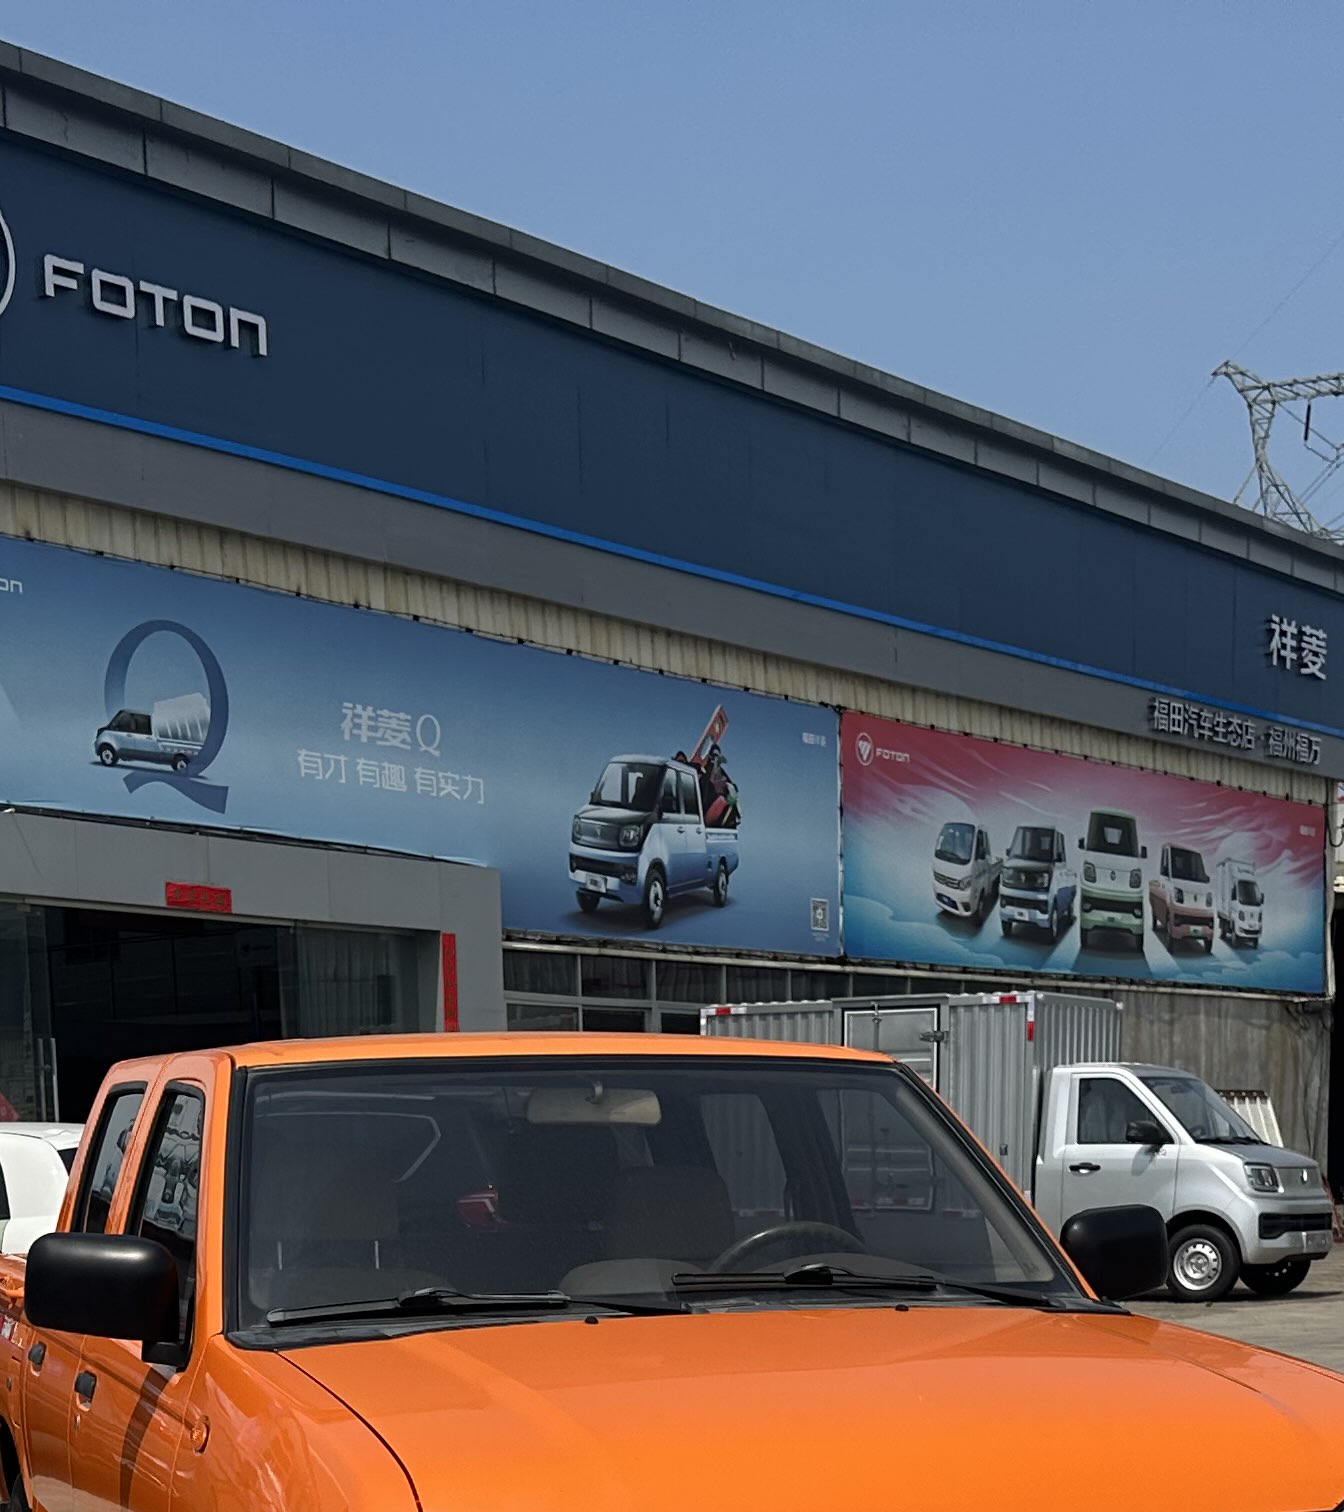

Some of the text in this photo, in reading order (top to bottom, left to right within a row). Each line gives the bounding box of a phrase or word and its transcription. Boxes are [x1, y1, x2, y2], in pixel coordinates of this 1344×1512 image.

[44, 253, 268, 357] FOTON
[1269, 614, 1327, 680] 祥菱
[876, 748, 910, 763] FOTON
[414, 766, 485, 805] 有实力
